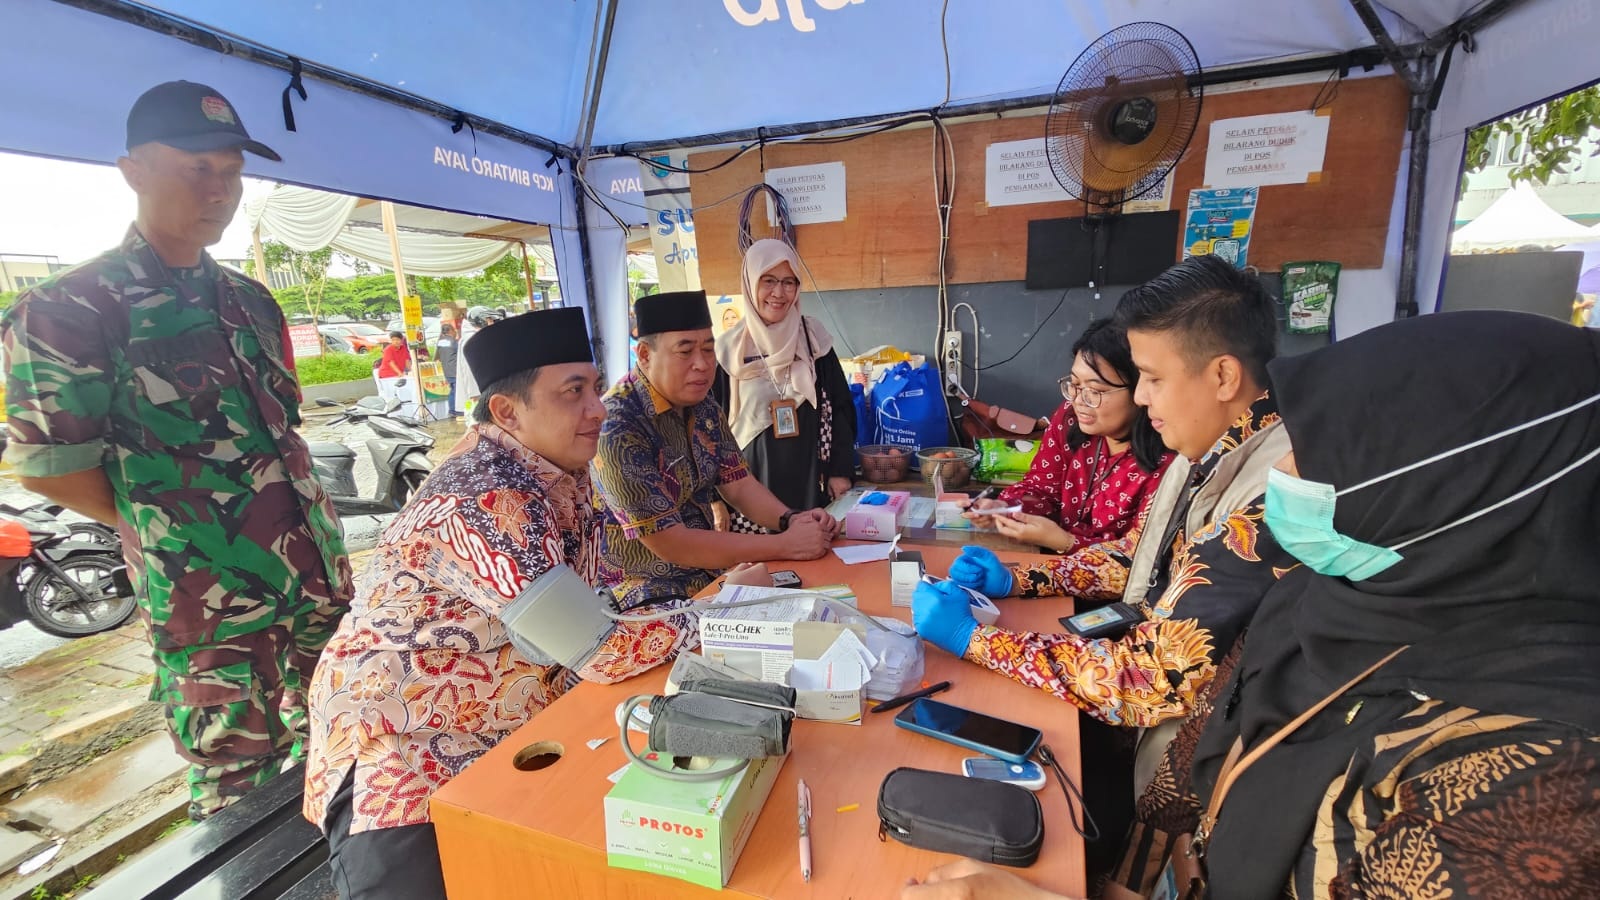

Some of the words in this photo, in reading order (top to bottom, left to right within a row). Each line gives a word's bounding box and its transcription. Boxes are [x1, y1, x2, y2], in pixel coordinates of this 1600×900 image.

[1226, 128, 1255, 137] SELAIN
[1254, 152, 1271, 160] POS
[703, 622, 762, 634] ACCU-CHEK
[639, 816, 704, 839] PROTOS
